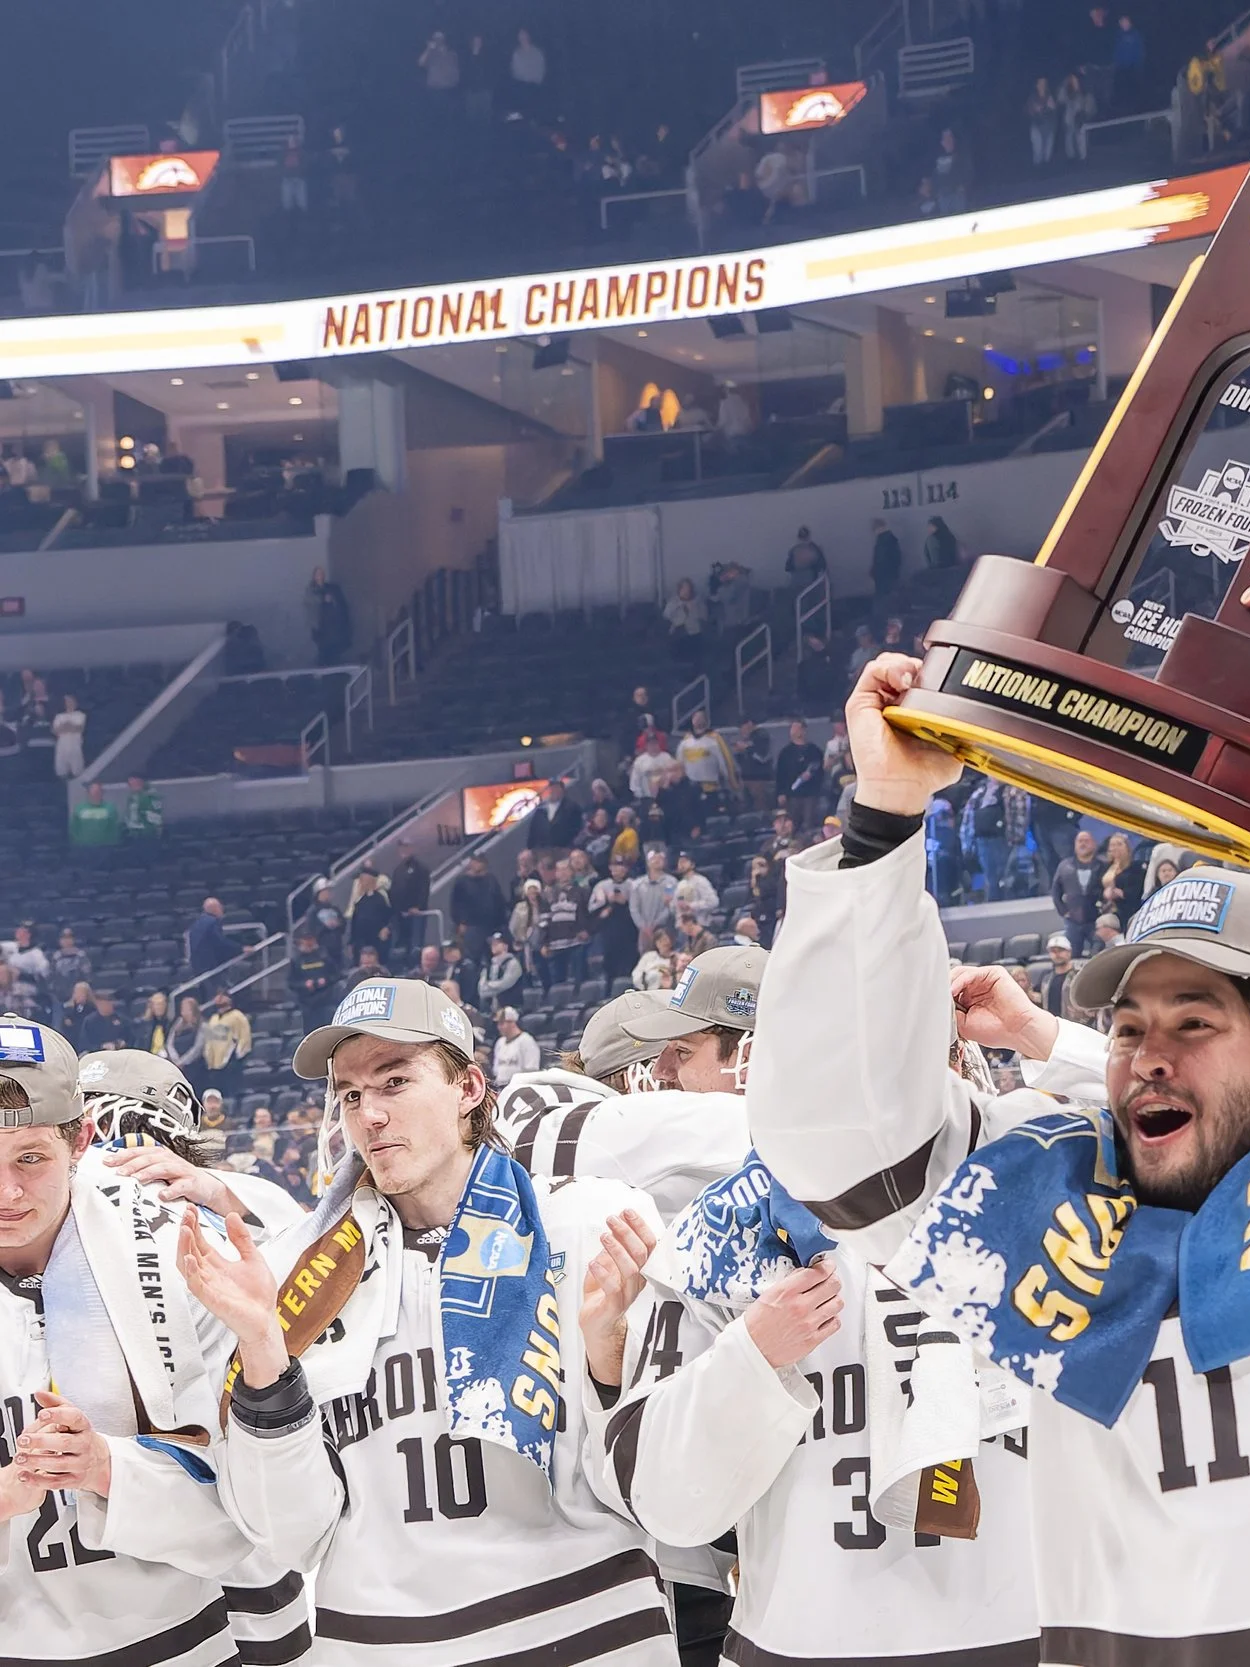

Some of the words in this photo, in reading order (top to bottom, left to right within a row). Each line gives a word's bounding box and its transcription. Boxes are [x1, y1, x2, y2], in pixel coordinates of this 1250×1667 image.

[322, 288, 507, 348] NATIONAL
[524, 258, 767, 326] CHAMPIONS
[882, 486, 912, 510] 113
[927, 481, 960, 504] 114
[1174, 496, 1227, 524] FROZEN
[1131, 608, 1163, 632] ICE
[1156, 616, 1183, 638] HO
[1123, 625, 1175, 652] CHAMPIO
[961, 659, 1060, 710] NATIONAL
[1056, 688, 1189, 755] CHAMPION
[1151, 881, 1221, 909] NATIONAL
[1142, 901, 1219, 932] CHAMPIONS
[339, 1000, 387, 1025] CHAMPIONS
[341, 987, 388, 1012] NATIONAL
[332, 1218, 362, 1254] M
[486, 1230, 510, 1271] NCAA
[550, 1257, 562, 1268] UR
[136, 1252, 166, 1324] MEN'S
[1142, 1356, 1250, 1493] 11
[397, 1433, 488, 1523] 10
